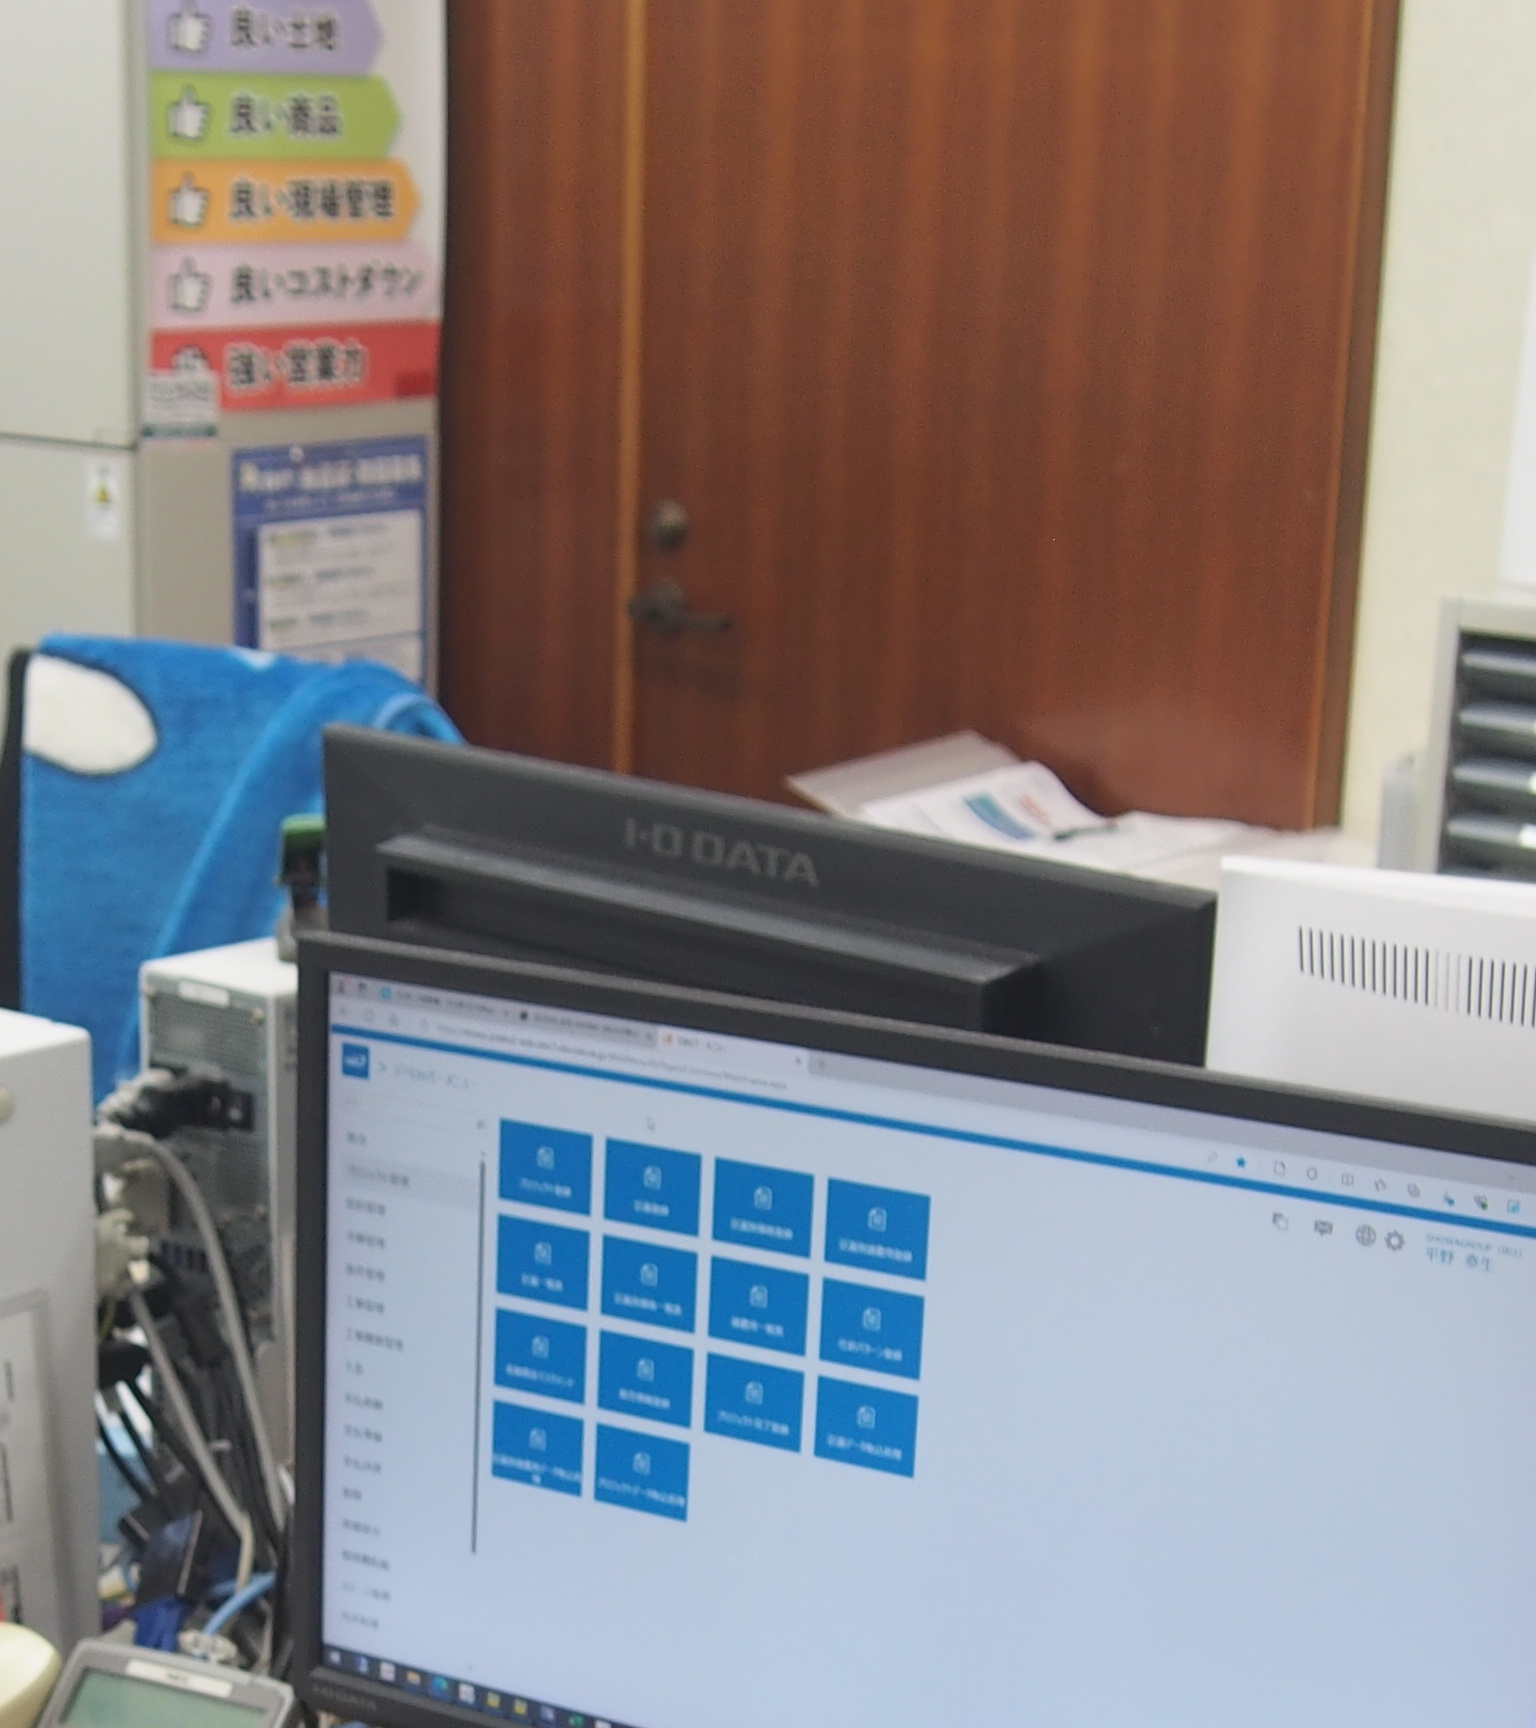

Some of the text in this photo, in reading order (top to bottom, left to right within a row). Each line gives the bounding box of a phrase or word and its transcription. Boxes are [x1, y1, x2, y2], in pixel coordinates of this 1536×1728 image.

[232, 7, 337, 50] 良い土地
[230, 94, 341, 136] 良い商品
[231, 179, 395, 221] 良い現場管理
[231, 259, 425, 305] 良いコストダウン
[228, 339, 366, 389] 強い営業力
[693, 830, 821, 887] DATA
